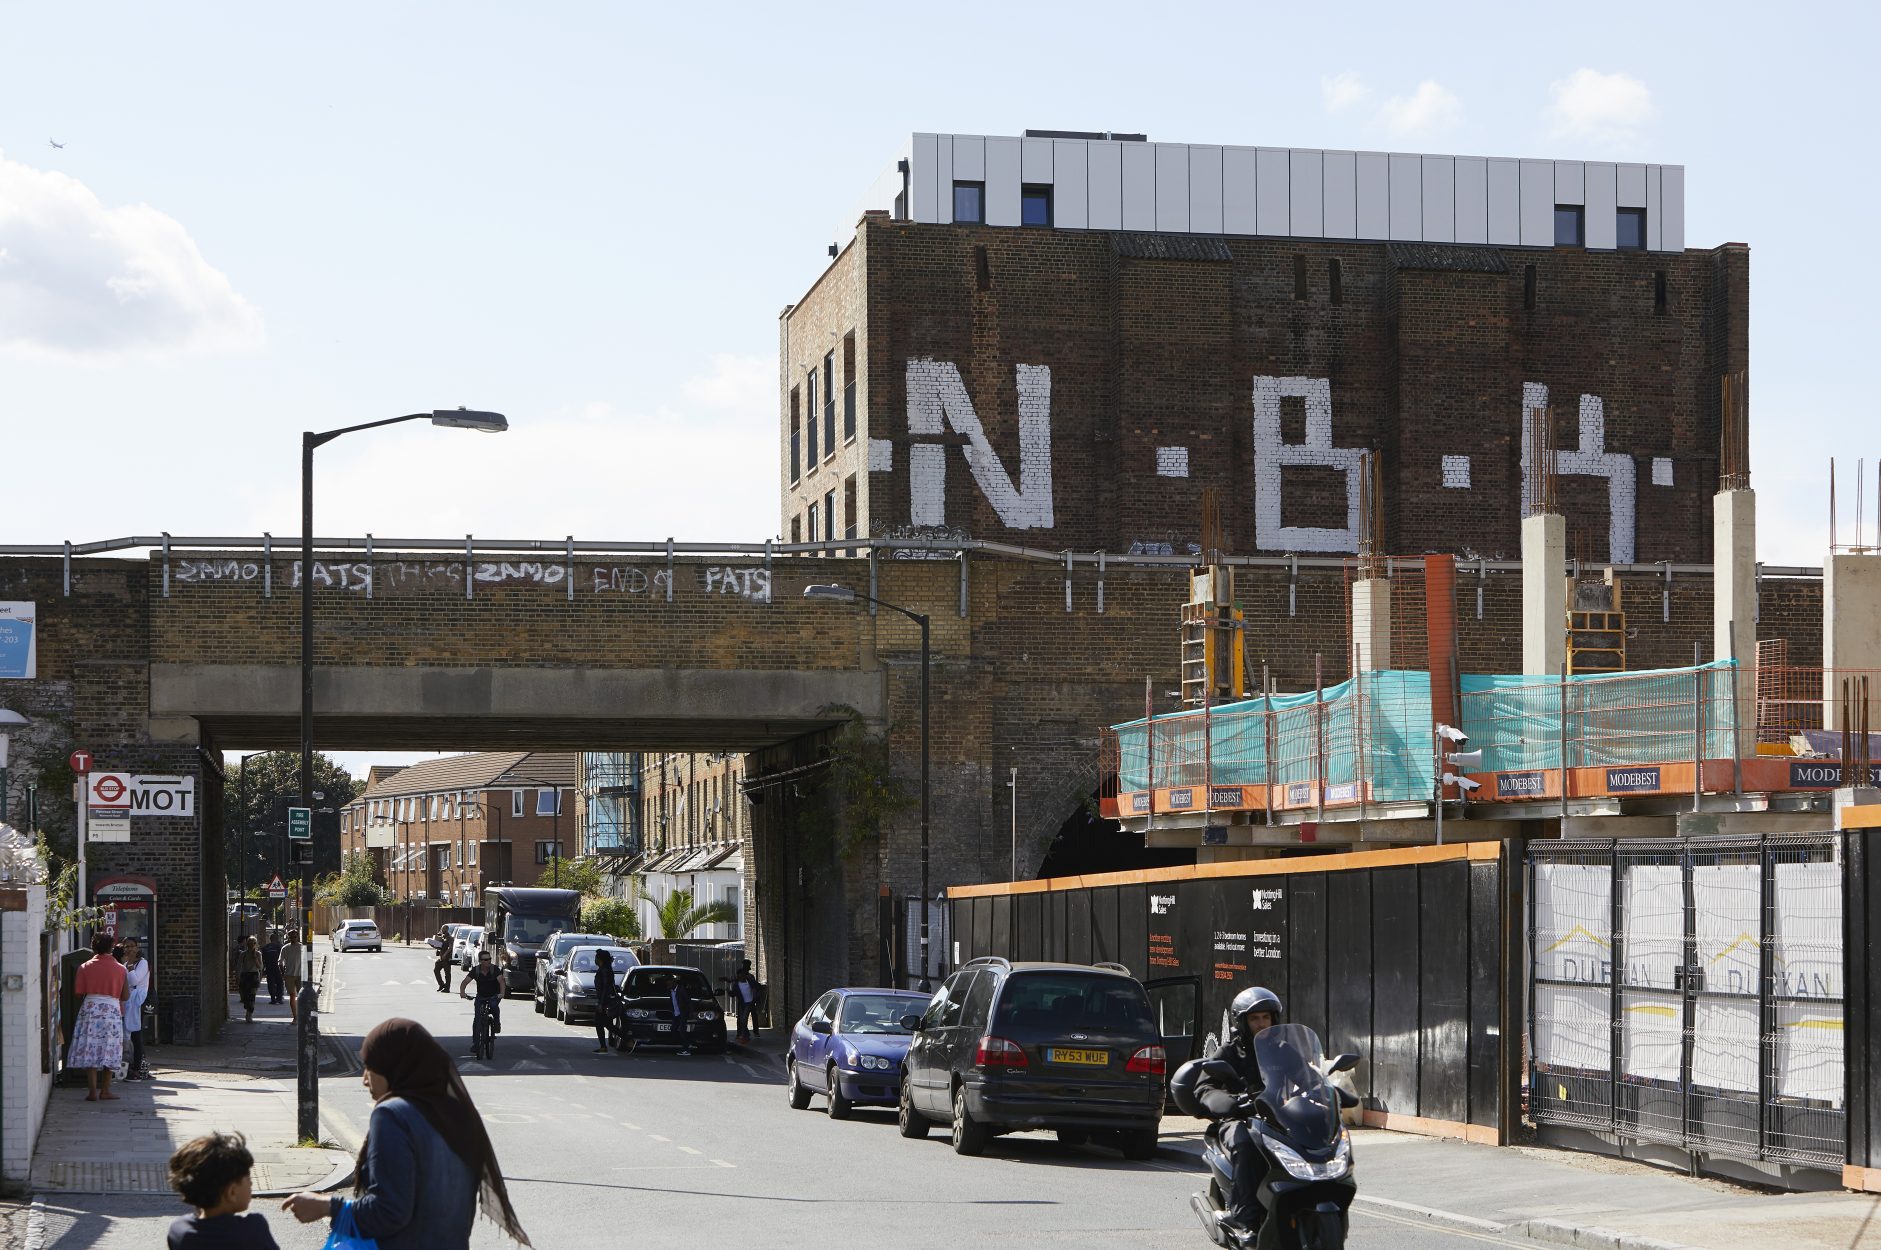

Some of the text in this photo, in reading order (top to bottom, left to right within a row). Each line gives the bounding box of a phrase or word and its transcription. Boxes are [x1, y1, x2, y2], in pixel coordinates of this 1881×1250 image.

[75, 754, 88, 770] T
[1500, 777, 1541, 790] MODEBEST
[1609, 772, 1657, 787] MODEBEST
[130, 789, 192, 810] MOT
[1171, 793, 1191, 804] MODEBEST
[1261, 899, 1272, 910] Sales
[1054, 1051, 1105, 1063] RY53 WUE
